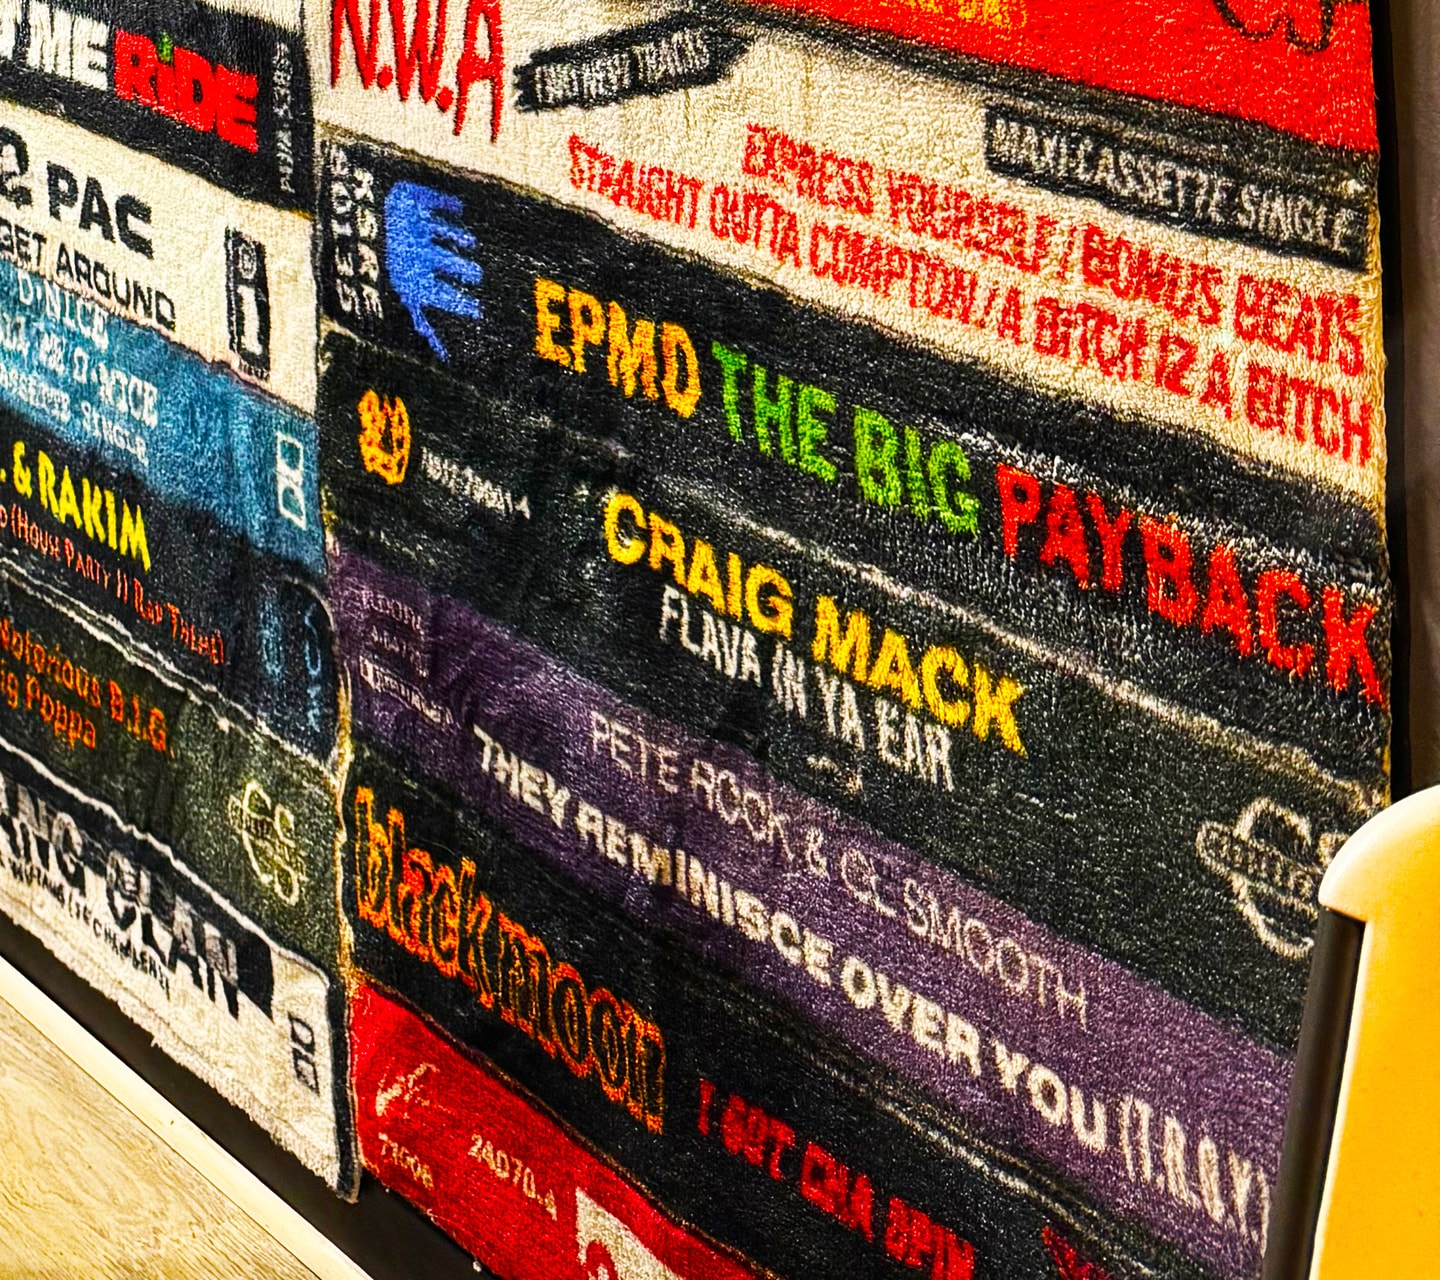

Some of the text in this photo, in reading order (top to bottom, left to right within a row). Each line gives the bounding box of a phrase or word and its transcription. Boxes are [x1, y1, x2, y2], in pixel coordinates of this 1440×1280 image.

[46, 160, 155, 260] PAC
[56, 247, 176, 333] AROUND
[709, 183, 802, 269] OUTTA
[12, 440, 33, 498] &
[37, 449, 153, 573] RAKIM
[533, 276, 1385, 704] EPMD THE BIG PAYBACK
[604, 491, 796, 640] CRAIG
[811, 594, 1028, 760] MACK
[661, 585, 762, 688] FLAVA
[772, 641, 808, 718] IN
[875, 697, 955, 793] EAR
[23, 678, 98, 750] Poppa
[473, 723, 1109, 1155] THEY REMINISCE OVER YOU
[590, 709, 680, 793] PETE
[903, 877, 1088, 1031] SMOOTH
